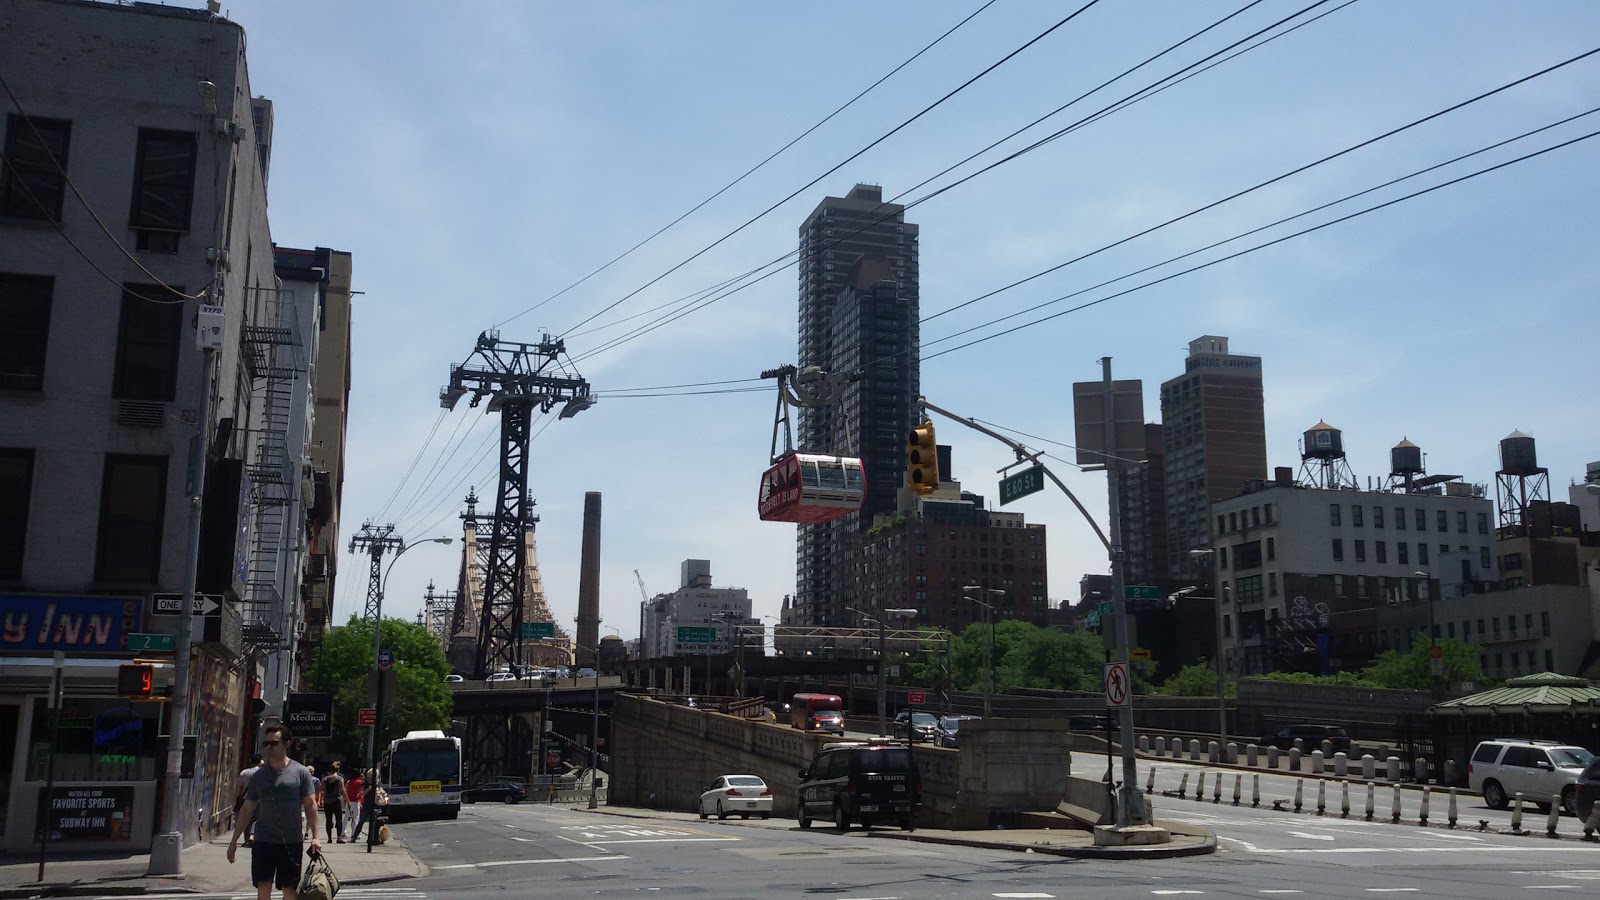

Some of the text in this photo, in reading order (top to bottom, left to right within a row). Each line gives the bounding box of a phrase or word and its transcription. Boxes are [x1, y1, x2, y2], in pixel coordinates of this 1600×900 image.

[1006, 474, 1034, 497] E 60 St
[1134, 588, 1141, 597] 2
[160, 600, 179, 609] ONE
[143, 636, 151, 648] 2
[100, 755, 136, 763] ATM
[52, 798, 116, 809] FAVORITE SPORTS
[60, 817, 106, 828] SUBWAY INN
